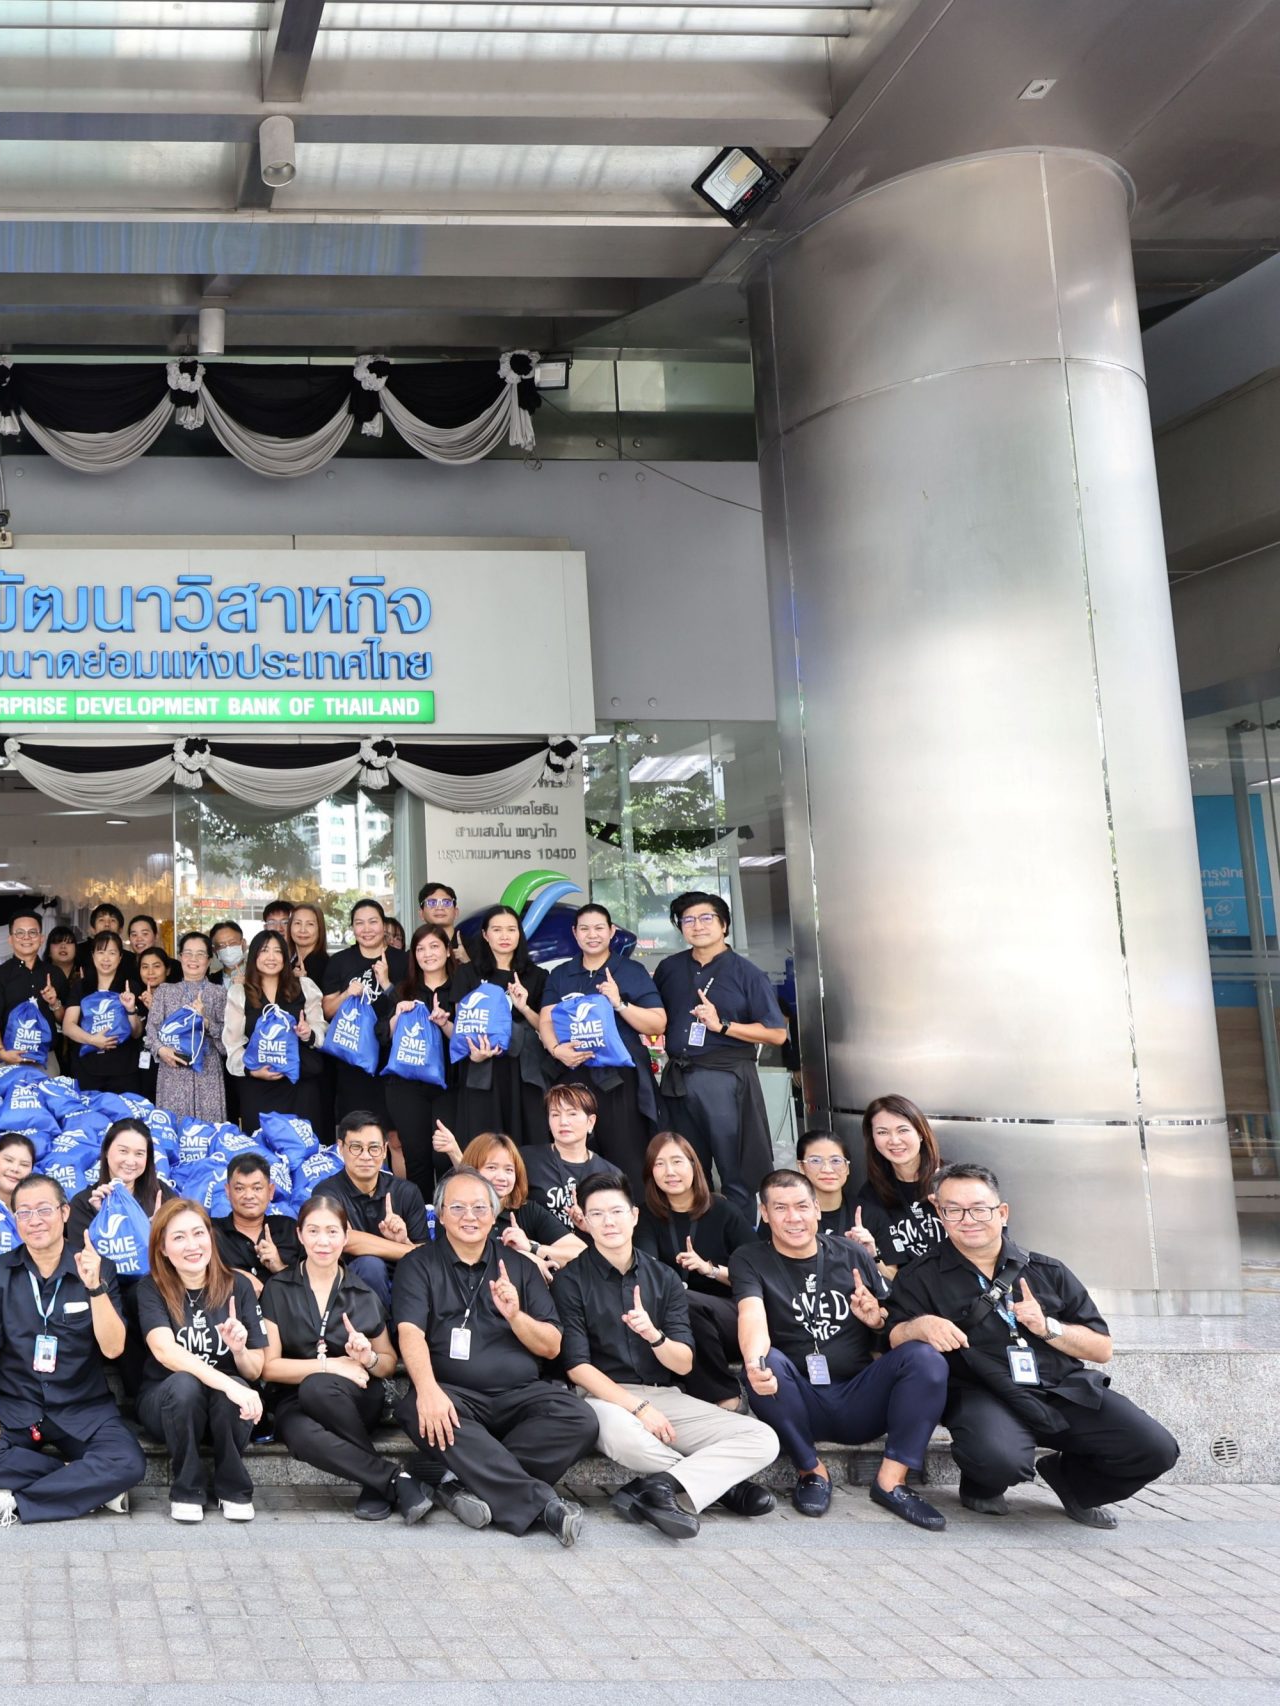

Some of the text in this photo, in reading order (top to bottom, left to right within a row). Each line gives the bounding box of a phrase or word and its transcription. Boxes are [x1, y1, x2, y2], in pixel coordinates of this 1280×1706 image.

[76, 696, 219, 717] DEVELOPMENT
[228, 697, 281, 717] BANK
[289, 697, 315, 717] OF
[323, 697, 421, 717] THAILAND
[537, 848, 577, 860] 10400
[458, 1009, 489, 1020] SME
[16, 1027, 42, 1041] SME
[337, 1018, 360, 1037] SME
[455, 1023, 488, 1034] Bank
[570, 1020, 603, 1035] SME
[258, 1039, 287, 1052] SME
[333, 1033, 359, 1051] Bank
[400, 1035, 426, 1051] SME
[258, 1053, 288, 1065] Bank
[396, 1052, 426, 1066] Bank
[11, 1099, 42, 1110] Bank
[180, 1136, 208, 1147] SME
[180, 1152, 207, 1163] Bank
[303, 1161, 336, 1177] Bank
[97, 1236, 137, 1254] SME
[830, 1290, 850, 1320] D
[177, 1326, 213, 1353] SME
